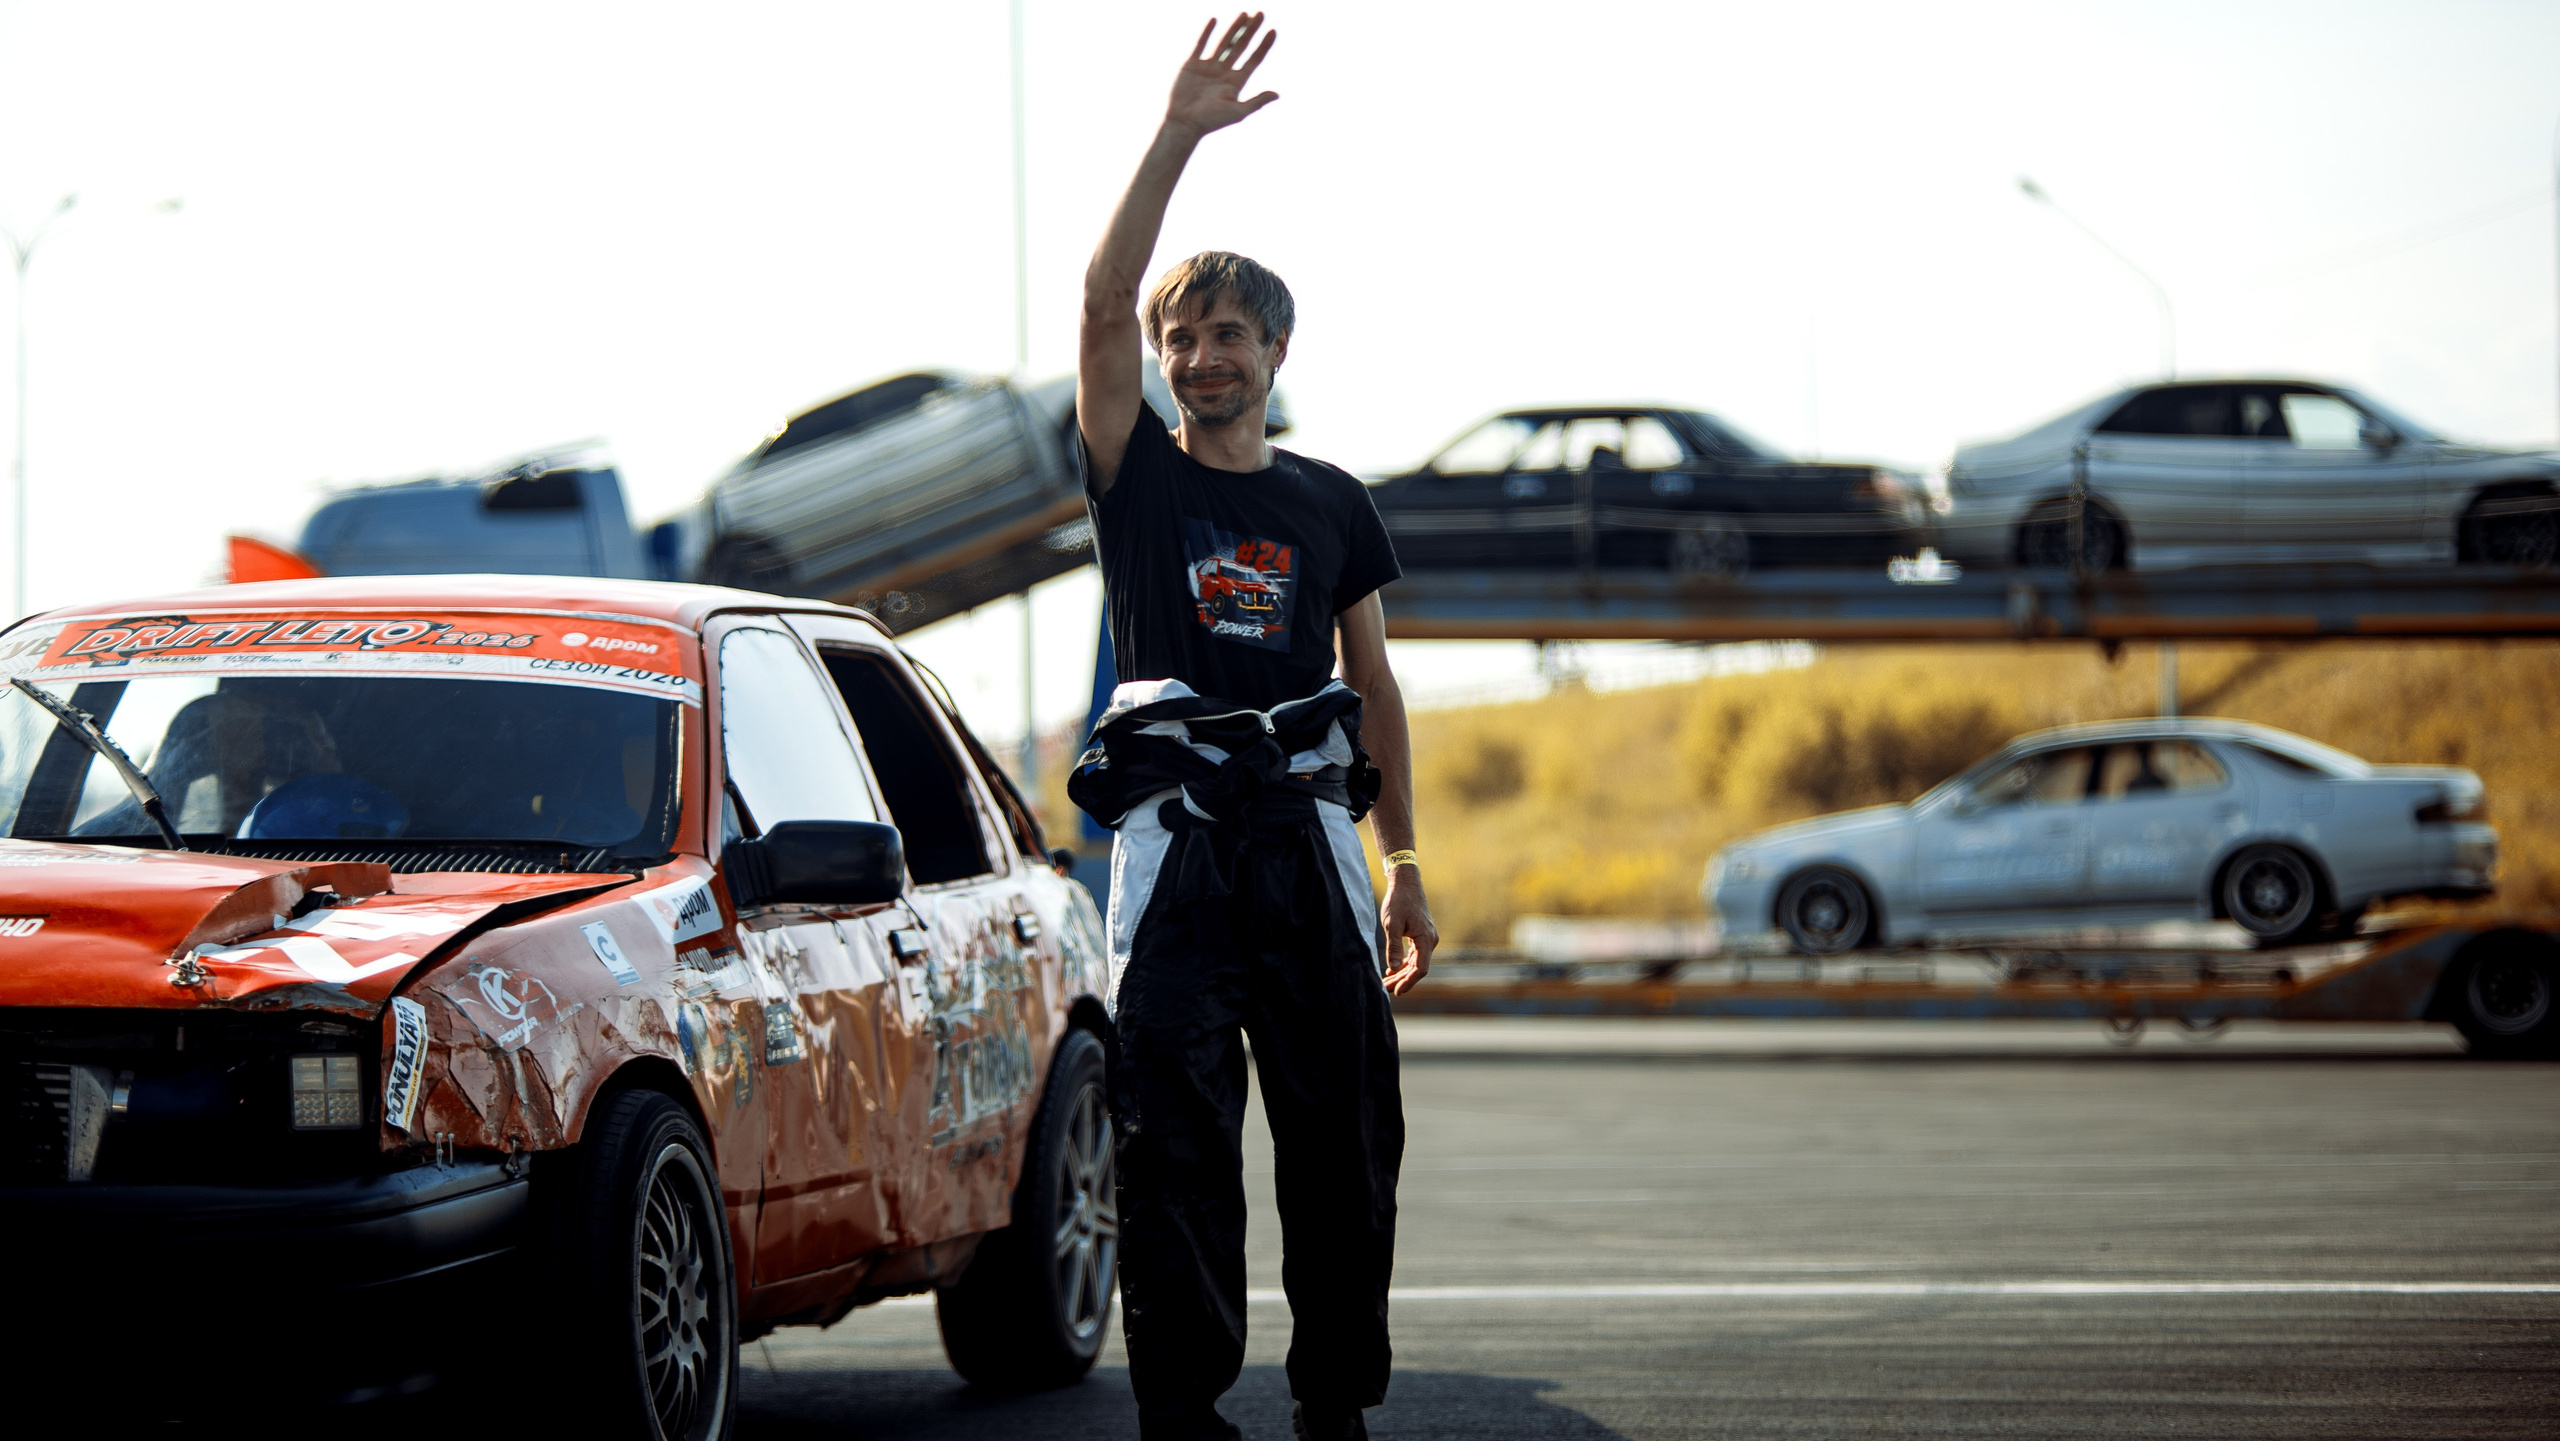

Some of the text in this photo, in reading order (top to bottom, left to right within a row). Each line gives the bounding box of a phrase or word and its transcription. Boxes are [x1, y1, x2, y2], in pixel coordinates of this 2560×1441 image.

[1235, 540, 1292, 574] #24
[63, 621, 278, 657] DRIFT
[1211, 619, 1265, 640] POWER
[529, 658, 611, 675] СЕЗОН
[387, 1004, 419, 1124] PONULYAM
